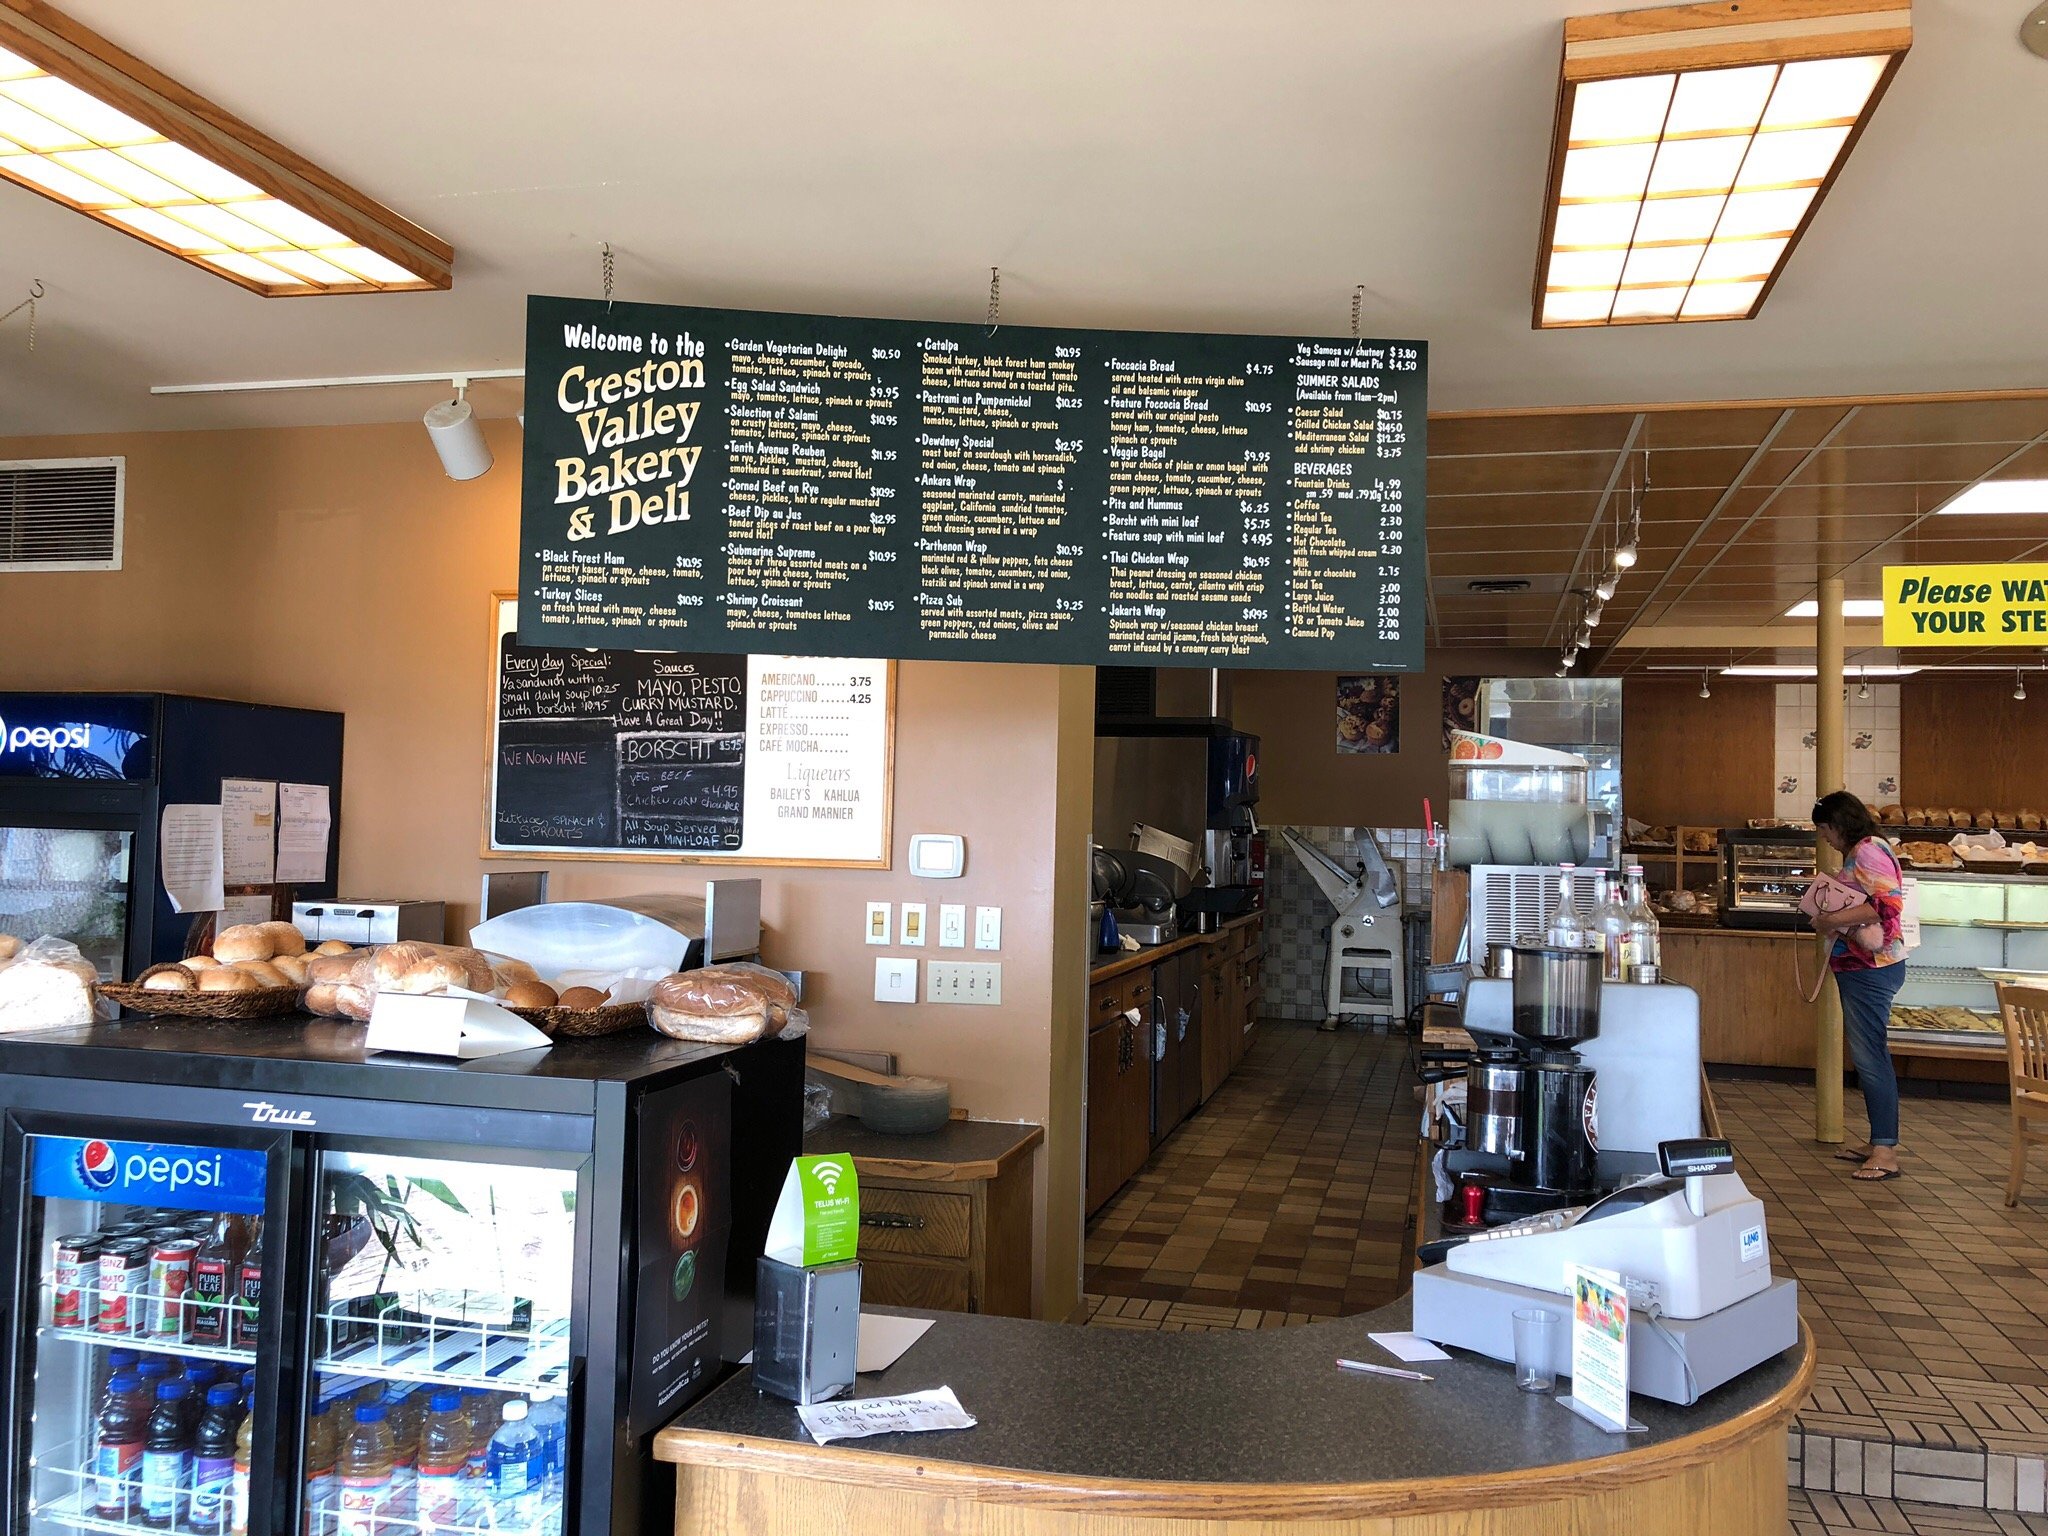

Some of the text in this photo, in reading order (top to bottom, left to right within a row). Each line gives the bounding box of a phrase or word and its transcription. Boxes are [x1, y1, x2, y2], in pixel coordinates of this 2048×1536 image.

[563, 323, 706, 358] Welcome to the
[925, 338, 958, 353] Catalpa
[731, 338, 847, 359] Garden Vegetarian Delight
[872, 347, 901, 360] $10.50
[1111, 358, 1175, 372] Foccacia Bread
[557, 357, 706, 414] Creston
[731, 378, 821, 394] Egg Salad Sandwich
[1297, 374, 1379, 388] SUMMER SALADS
[870, 386, 900, 400] $9.95
[922, 391, 1031, 409] Pastrami on Pumpernickel
[1055, 396, 1083, 410] $10.25
[730, 404, 818, 421] Selection of Salami
[575, 398, 701, 456] Valley
[730, 440, 825, 457] Tenth Avenue Reuben
[922, 433, 994, 450] Dewdney Special
[871, 449, 897, 461] $11.95
[553, 445, 703, 505] Bakery
[1294, 463, 1352, 475] BEVERAGES
[1109, 497, 1183, 510] Pita and Hummus
[1294, 500, 1320, 510] Coffee
[1381, 504, 1402, 513] 2.00
[566, 482, 691, 542] & Deli
[1294, 512, 1332, 523] Herbal Tea
[1380, 516, 1402, 526] 2.30
[920, 539, 987, 555] Parthenon Wrap
[1056, 544, 1083, 556] $10.95
[542, 549, 625, 565] Black Forest Ham
[1110, 551, 1189, 567] Thai Chicken Wrap
[1293, 579, 1323, 590] Iced Tea
[1380, 583, 1400, 593] 3.00
[1899, 577, 2048, 604] Please WA
[541, 587, 603, 603] Turkey Slices
[920, 593, 963, 606] Pizza Sub
[1109, 604, 1166, 619] Jakarta Wrap
[1911, 611, 1986, 633] YOUR
[1292, 628, 1335, 640] Canned Pop
[1379, 631, 1400, 640] 2.00
[571, 653, 611, 671] Special:
[653, 659, 695, 674] Sauces
[568, 674, 594, 684] with
[691, 677, 741, 695] PESTO,
[850, 677, 871, 687] 3.75
[502, 691, 529, 704] small
[535, 691, 560, 705] daily
[565, 690, 590, 701] soup
[760, 690, 818, 703] CAPPUCCINO
[849, 694, 871, 704] 4.25
[503, 704, 531, 717] with
[537, 702, 576, 714] borscht
[622, 697, 664, 712] CURRY
[612, 713, 640, 727] Have
[646, 711, 652, 726] A
[656, 712, 683, 726] Great
[9, 723, 90, 754] pepsi
[628, 738, 715, 762] BORSCHT
[502, 751, 521, 765] WE
[557, 751, 587, 765] HAVE
[787, 763, 851, 786] Liqueurs
[770, 788, 860, 802] BAILEY'S KAHLUA
[777, 806, 853, 820] GRAND MARNIER
[553, 816, 594, 826] SPINACH
[625, 820, 717, 835] All Soup Served
[520, 825, 583, 839] SPROUTS
[653, 836, 659, 844] A
[242, 1101, 317, 1126] true
[123, 1153, 221, 1192] pepsi
[1687, 1164, 1717, 1172] SHARP
[814, 1199, 834, 1208] TELUS
[1743, 1231, 1759, 1246] LANG
[100, 1259, 122, 1268] EINZ
[199, 1274, 221, 1283] PURE
[652, 1353, 660, 1365] DO
[660, 1347, 669, 1358] YOU
[669, 1337, 681, 1352] KNOW
[681, 1329, 692, 1342] YOUR
[830, 1403, 857, 1415] Try
[861, 1401, 882, 1410] our
